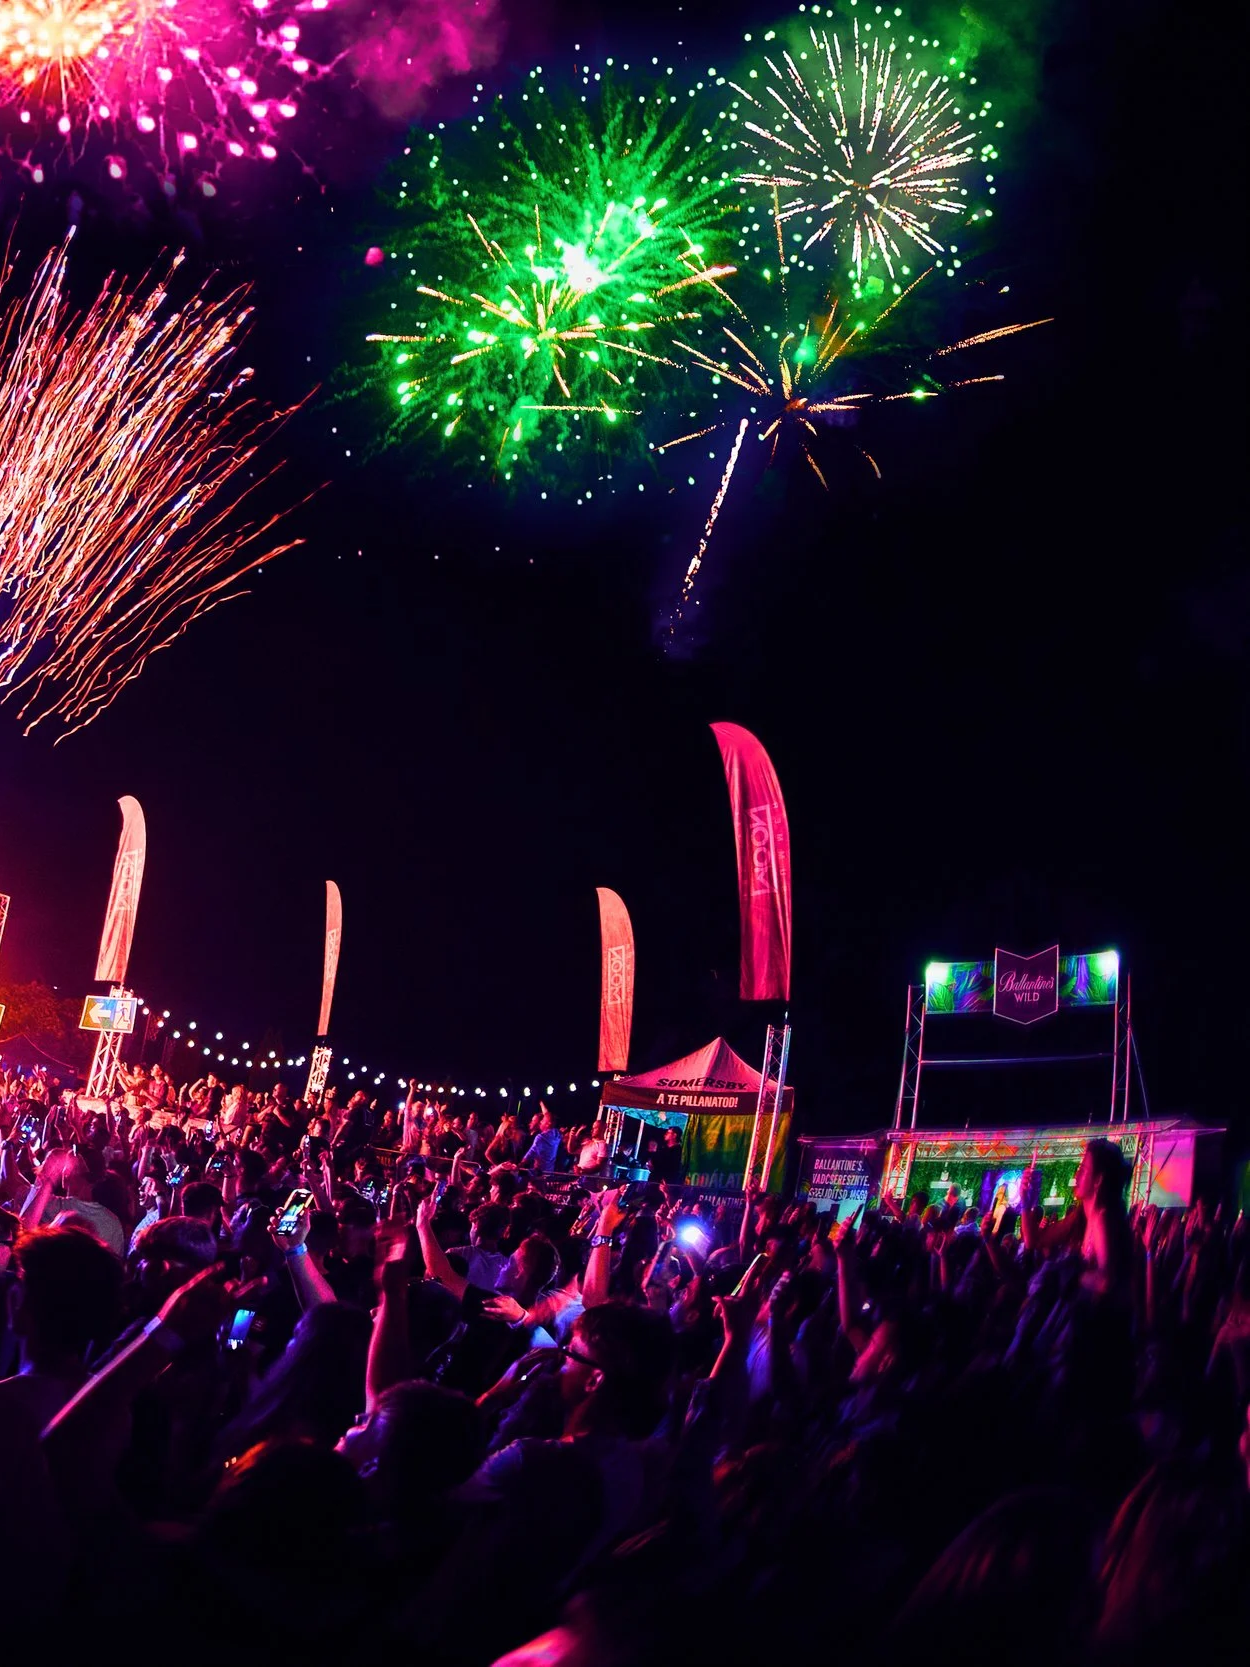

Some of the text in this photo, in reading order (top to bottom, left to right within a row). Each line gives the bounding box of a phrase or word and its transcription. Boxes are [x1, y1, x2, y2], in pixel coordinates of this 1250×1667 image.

[998, 970, 1055, 993] Ballantine's
[1014, 992, 1040, 1003] WILD
[656, 1093, 739, 1108] A TE PILLANATOD!
[812, 1173, 870, 1187] VADCSERESZNYE.
